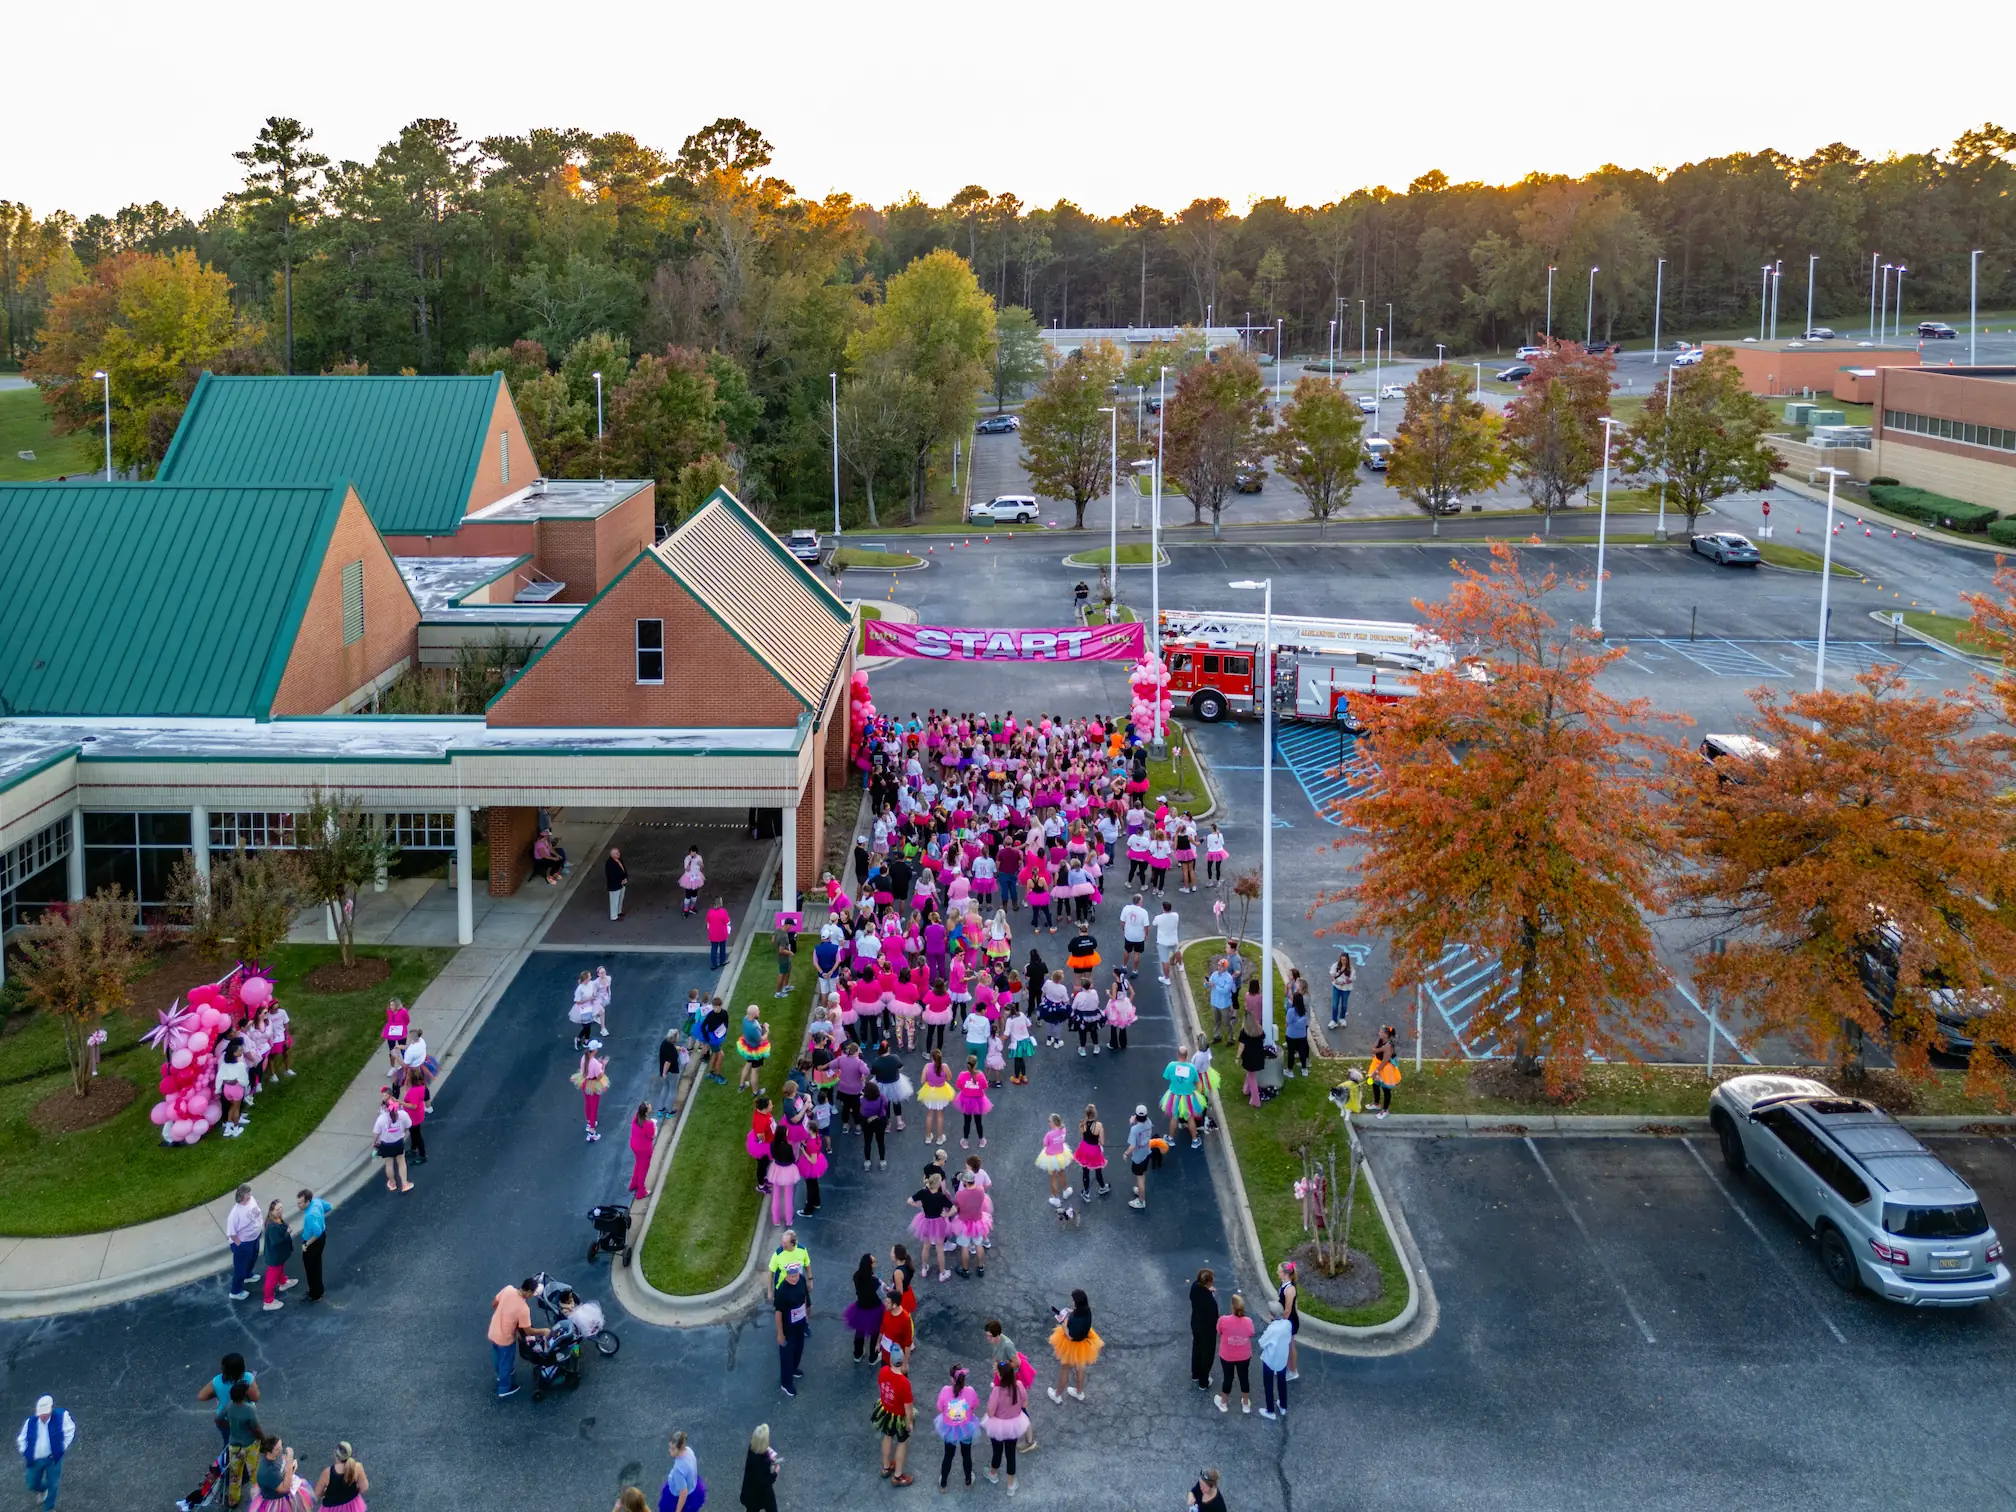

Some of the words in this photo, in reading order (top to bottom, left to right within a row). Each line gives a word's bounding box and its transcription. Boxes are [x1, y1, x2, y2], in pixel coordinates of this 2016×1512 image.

[914, 629, 1093, 659] START
[1301, 629, 1336, 638] ALEXANDER
[1353, 632, 1367, 640] FIRE
[1369, 633, 1409, 642] DEPARTMENT
